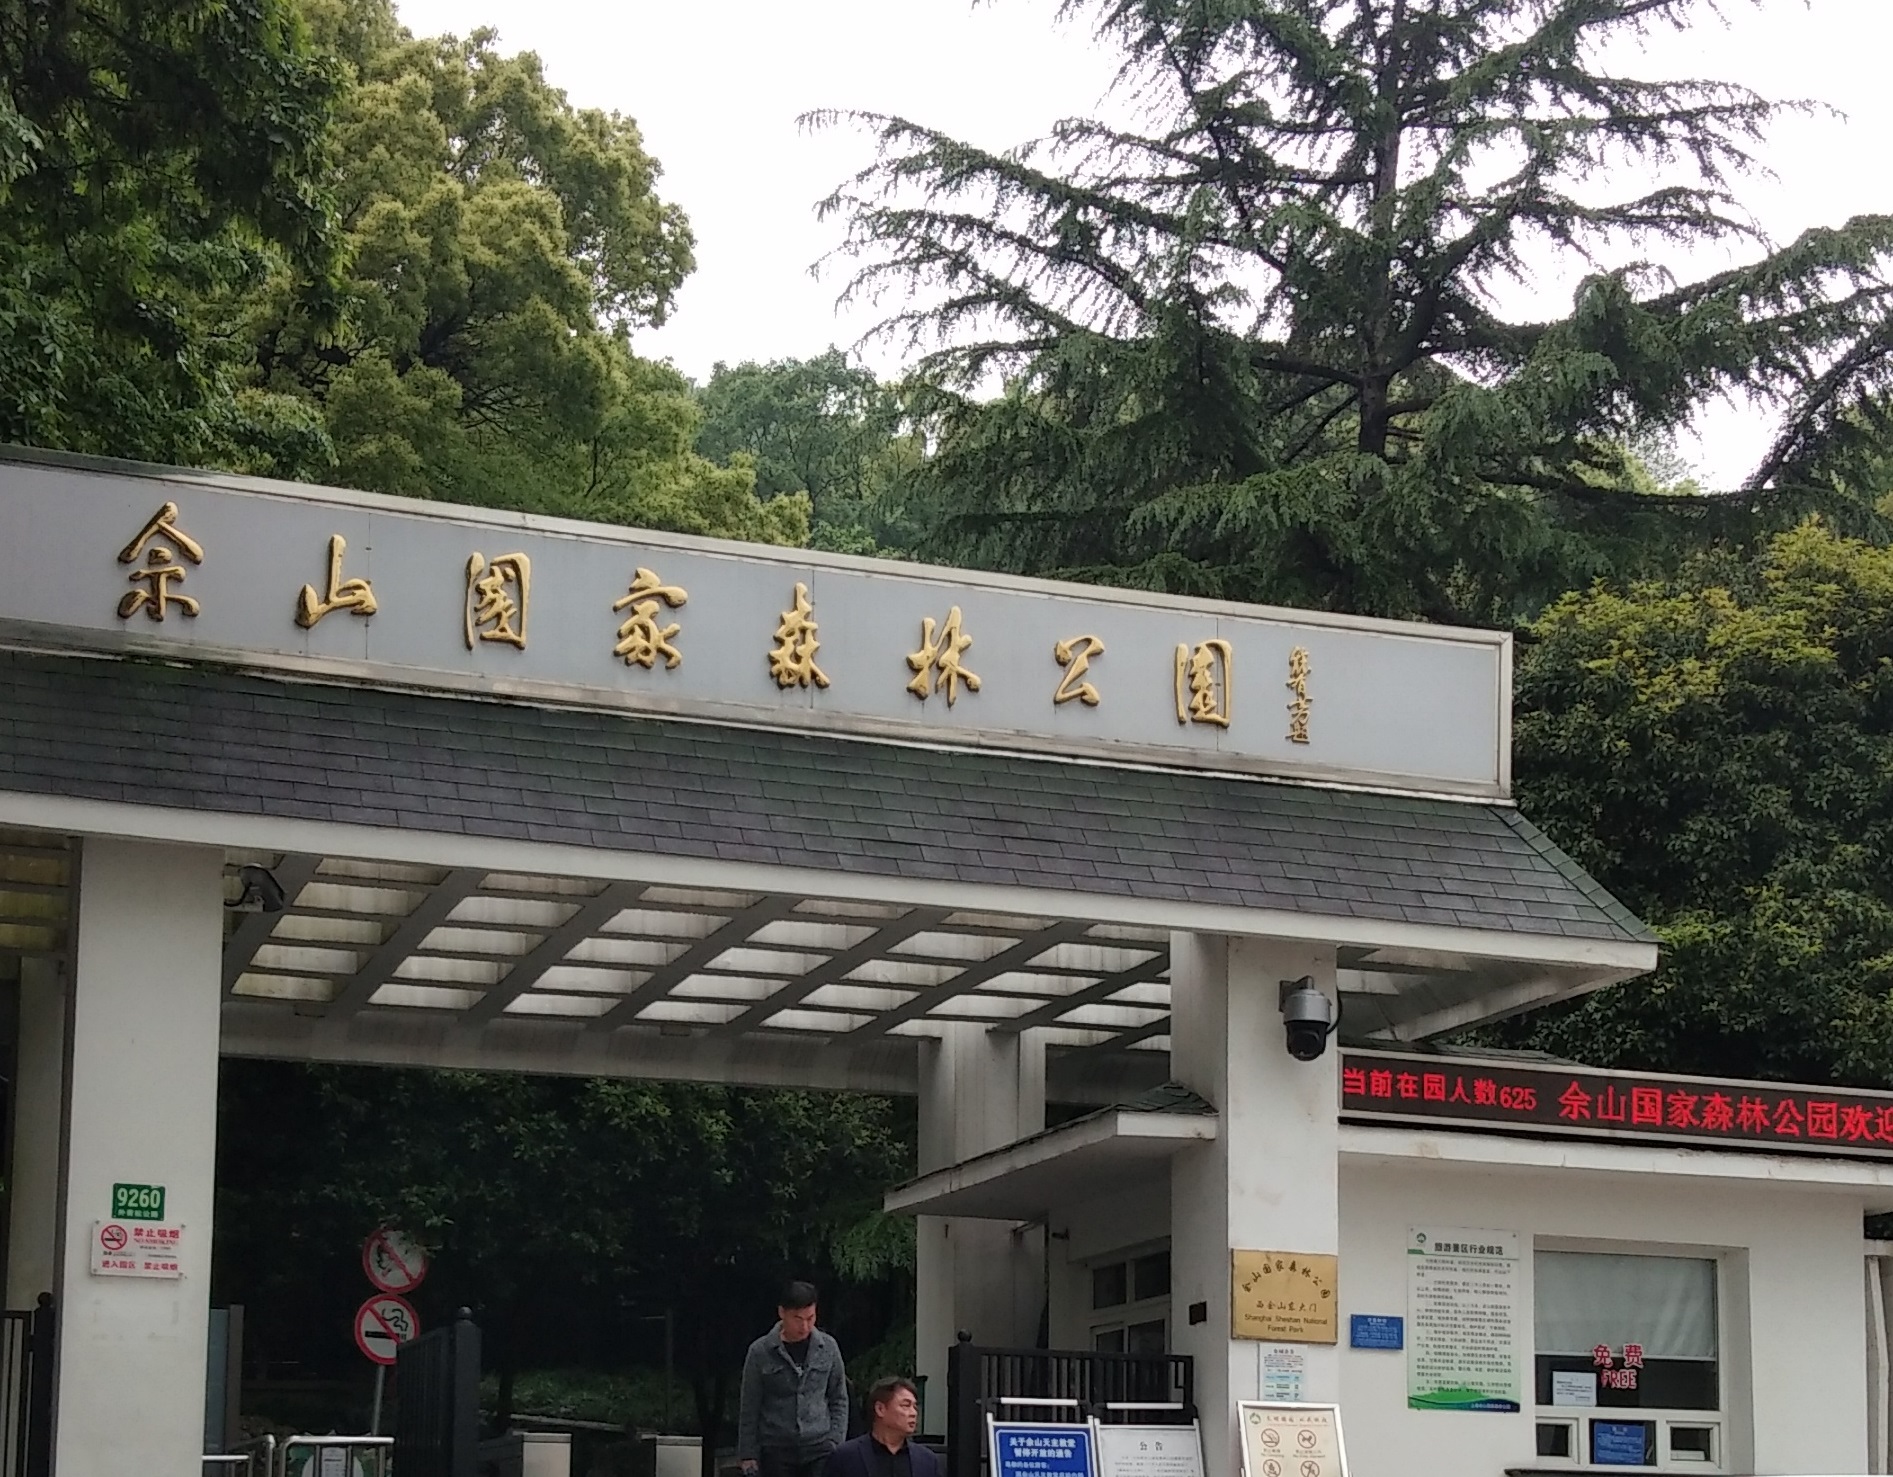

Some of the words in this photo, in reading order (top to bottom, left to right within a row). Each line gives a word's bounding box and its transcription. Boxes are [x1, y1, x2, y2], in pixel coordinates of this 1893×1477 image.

[1343, 1067, 1537, 1111] 当前在园人数625
[117, 1187, 161, 1209] 9260
[134, 1227, 180, 1238] 禁止吸烟
[1434, 1242, 1504, 1256] 旅游景区行业规范
[1244, 1313, 1272, 1323] Shanghai
[1303, 1317, 1328, 1325] National
[1267, 1324, 1287, 1332] Forest
[1289, 1325, 1304, 1333] Park
[1594, 1344, 1643, 1368] 免费
[1601, 1369, 1637, 1389] FREE
